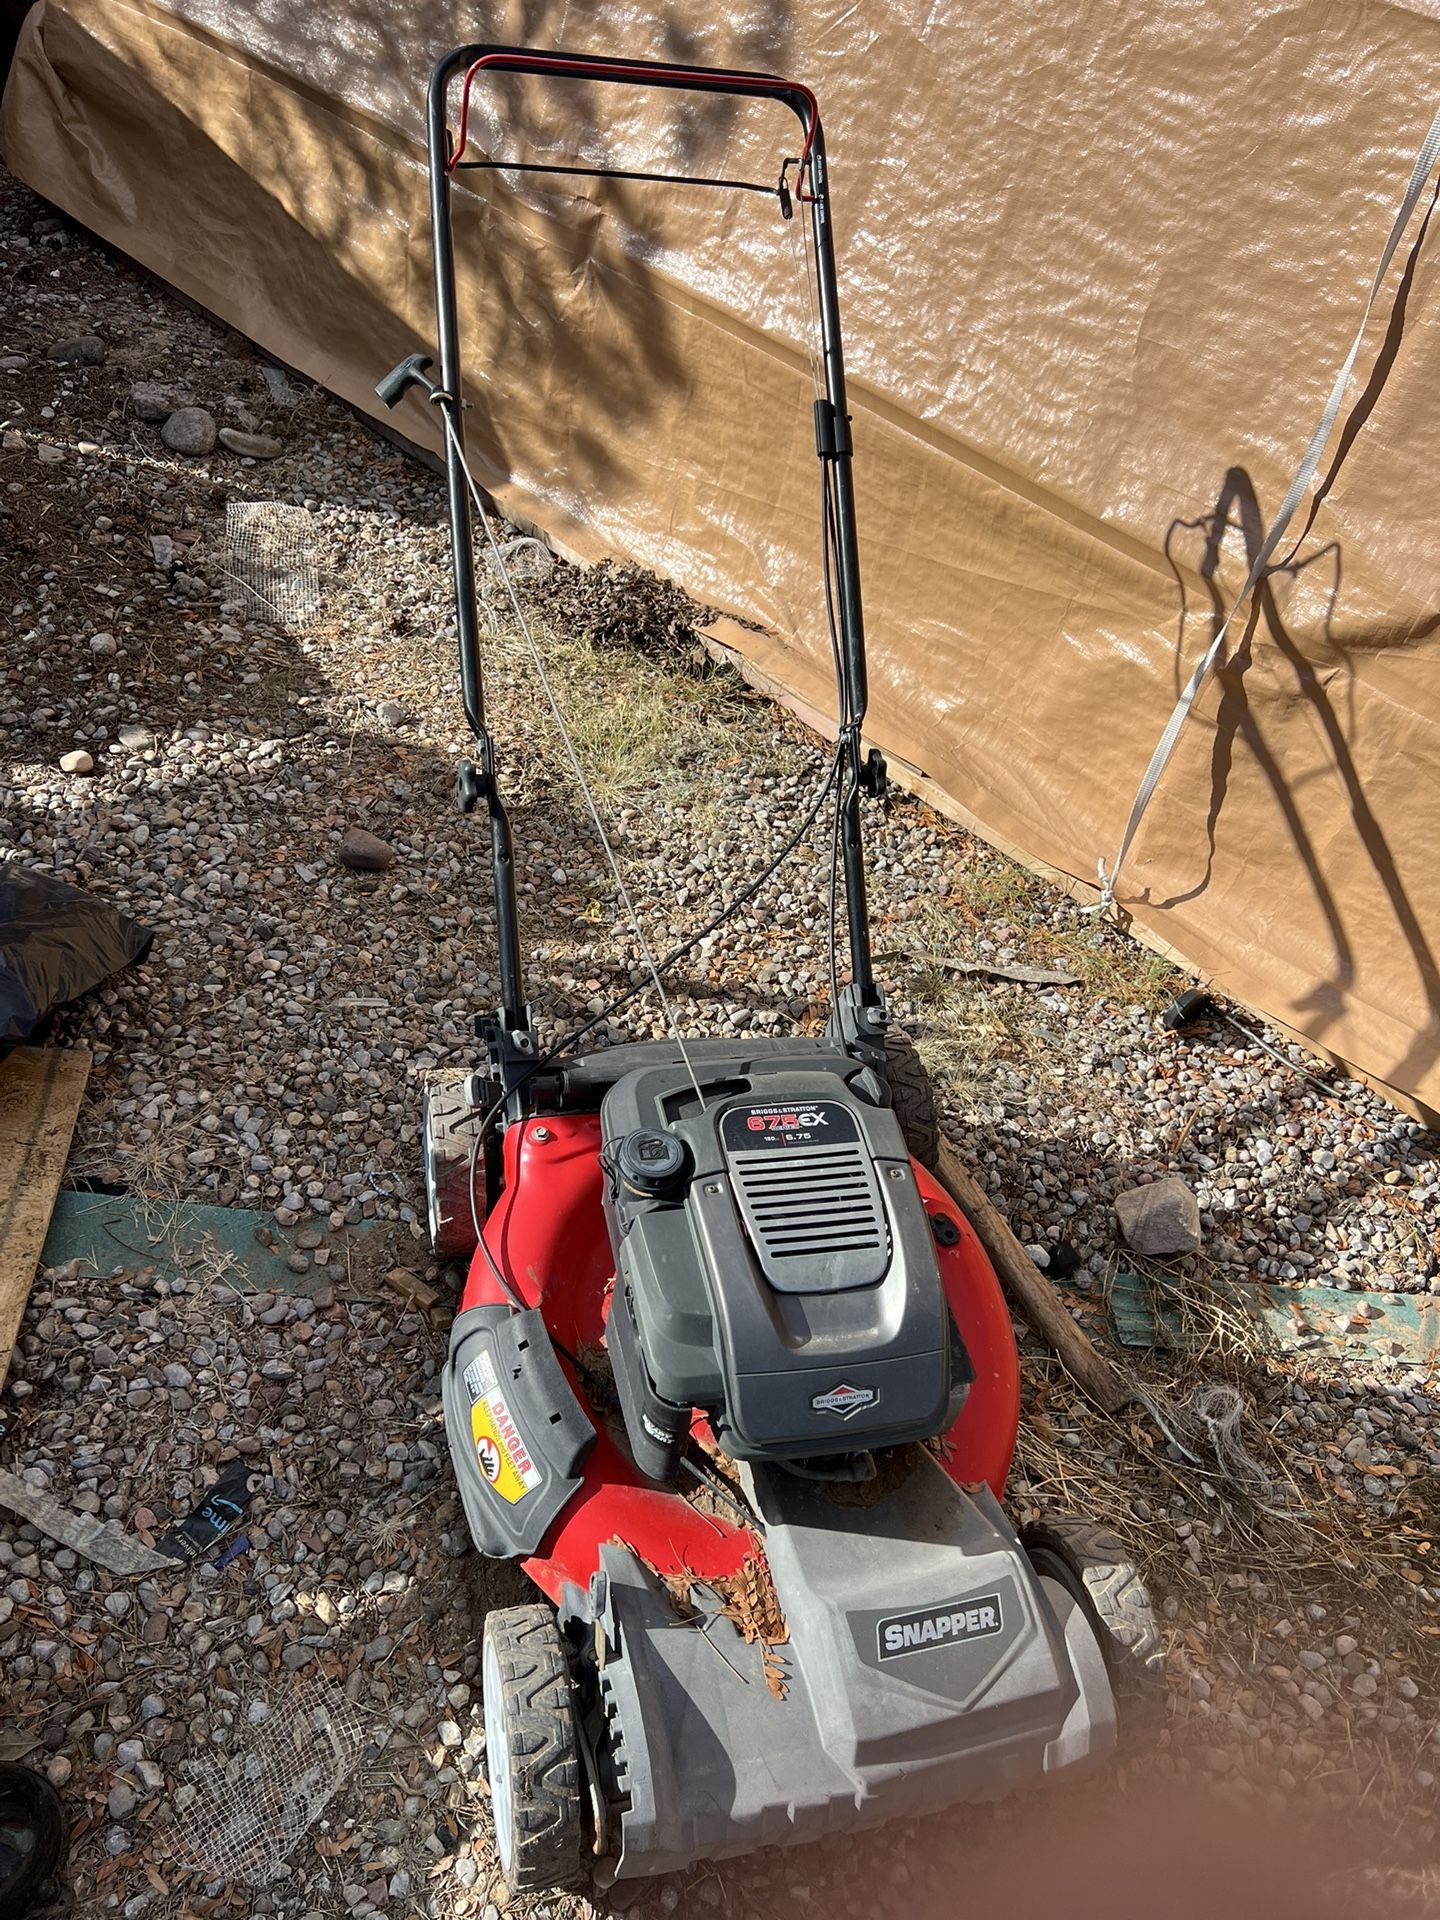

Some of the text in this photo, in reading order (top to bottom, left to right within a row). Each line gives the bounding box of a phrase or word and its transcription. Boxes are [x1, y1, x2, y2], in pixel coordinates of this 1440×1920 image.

[489, 1418, 500, 1442] HANDS
[504, 1454, 515, 1474] FEET
[513, 1470, 527, 1490] AWAY
[492, 1401, 532, 1475] DANGER
